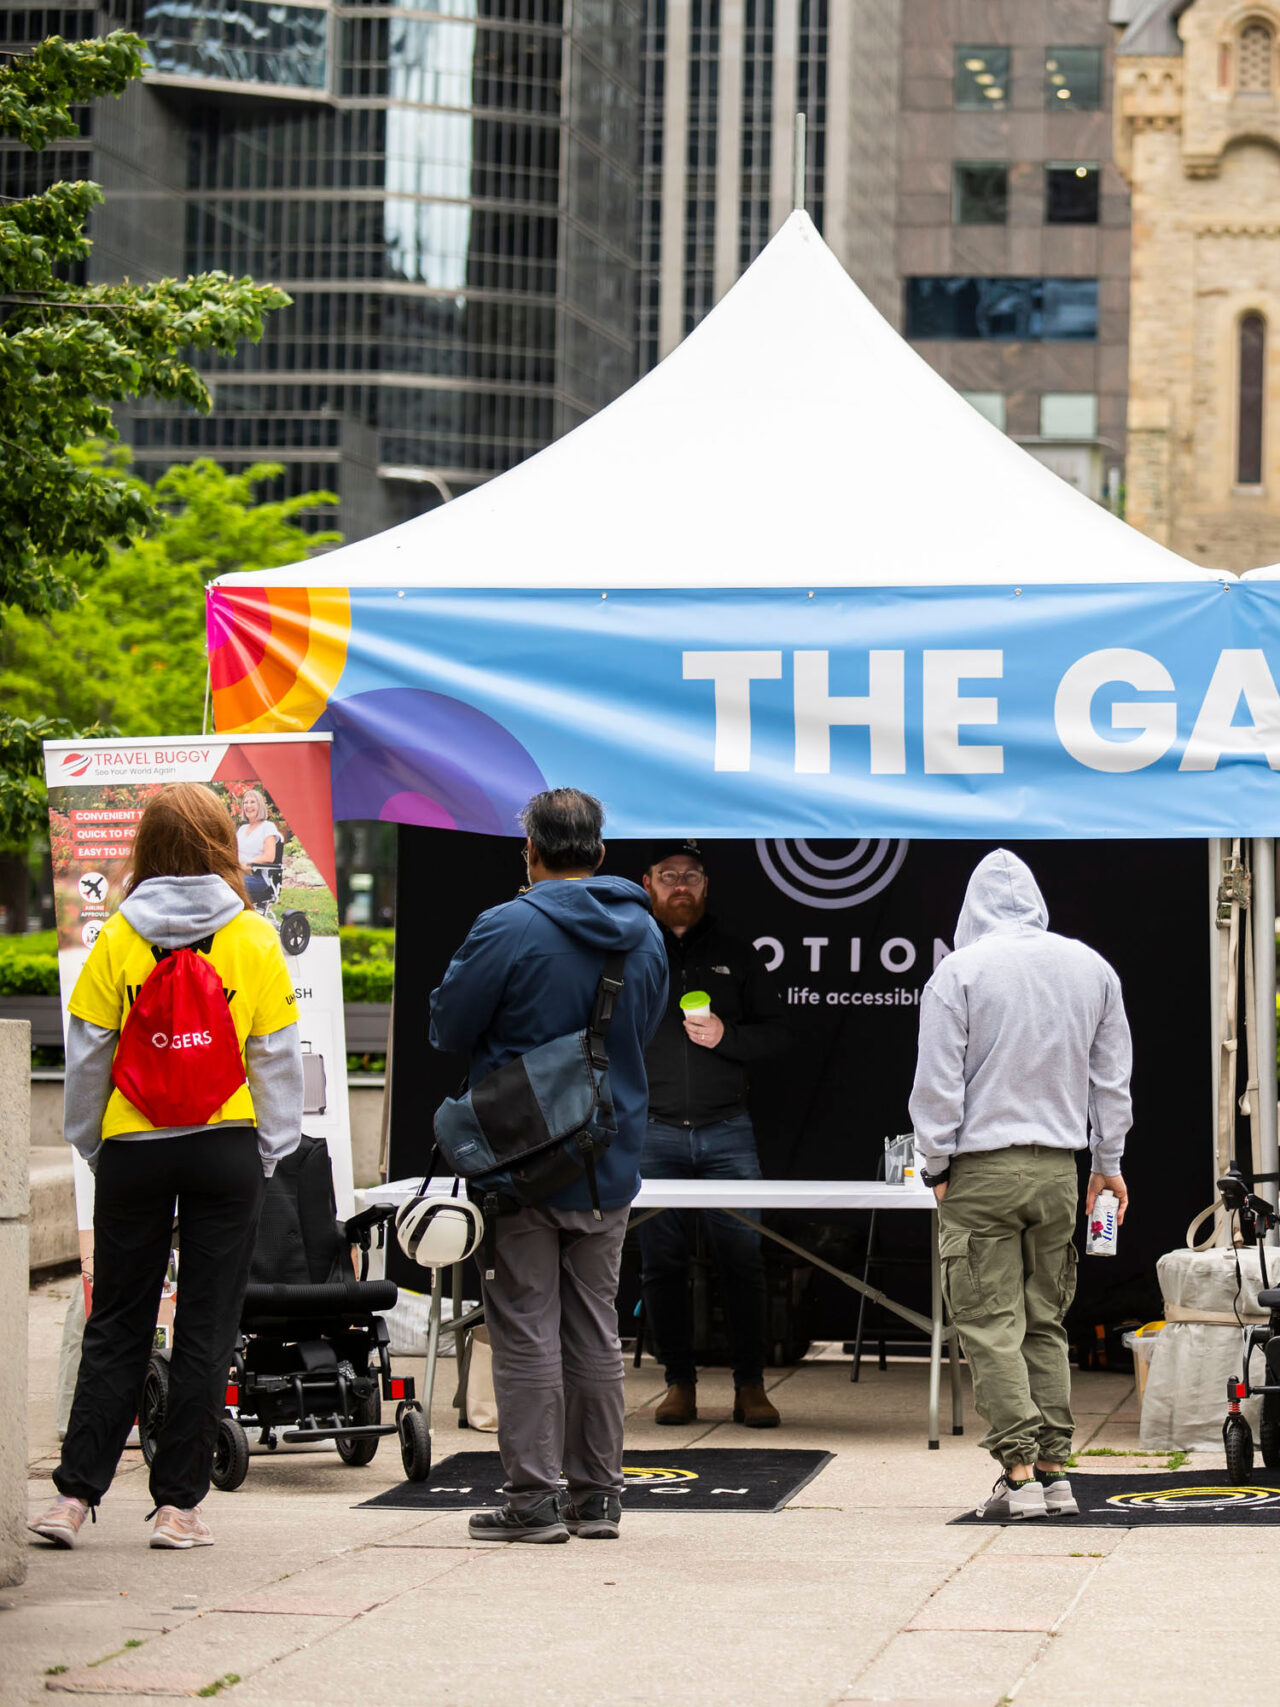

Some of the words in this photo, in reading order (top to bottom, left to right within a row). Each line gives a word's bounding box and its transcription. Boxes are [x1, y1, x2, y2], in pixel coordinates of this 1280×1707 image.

[681, 648, 1004, 775] THE
[94, 752, 151, 766] TRAVEL
[155, 750, 210, 764] BUGGY
[111, 768, 127, 776] Your
[153, 767, 176, 776] Again
[75, 812, 136, 821] CONVENIENT
[137, 811, 143, 820] T
[77, 830, 107, 839] QUICK
[108, 830, 122, 838] TO
[124, 829, 136, 838] FO
[78, 848, 101, 857] EASY
[103, 847, 117, 856] TO
[118, 847, 131, 856] US
[787, 987, 820, 1005] life
[826, 987, 921, 1005] accessibl
[1102, 1211, 1114, 1241] flow
